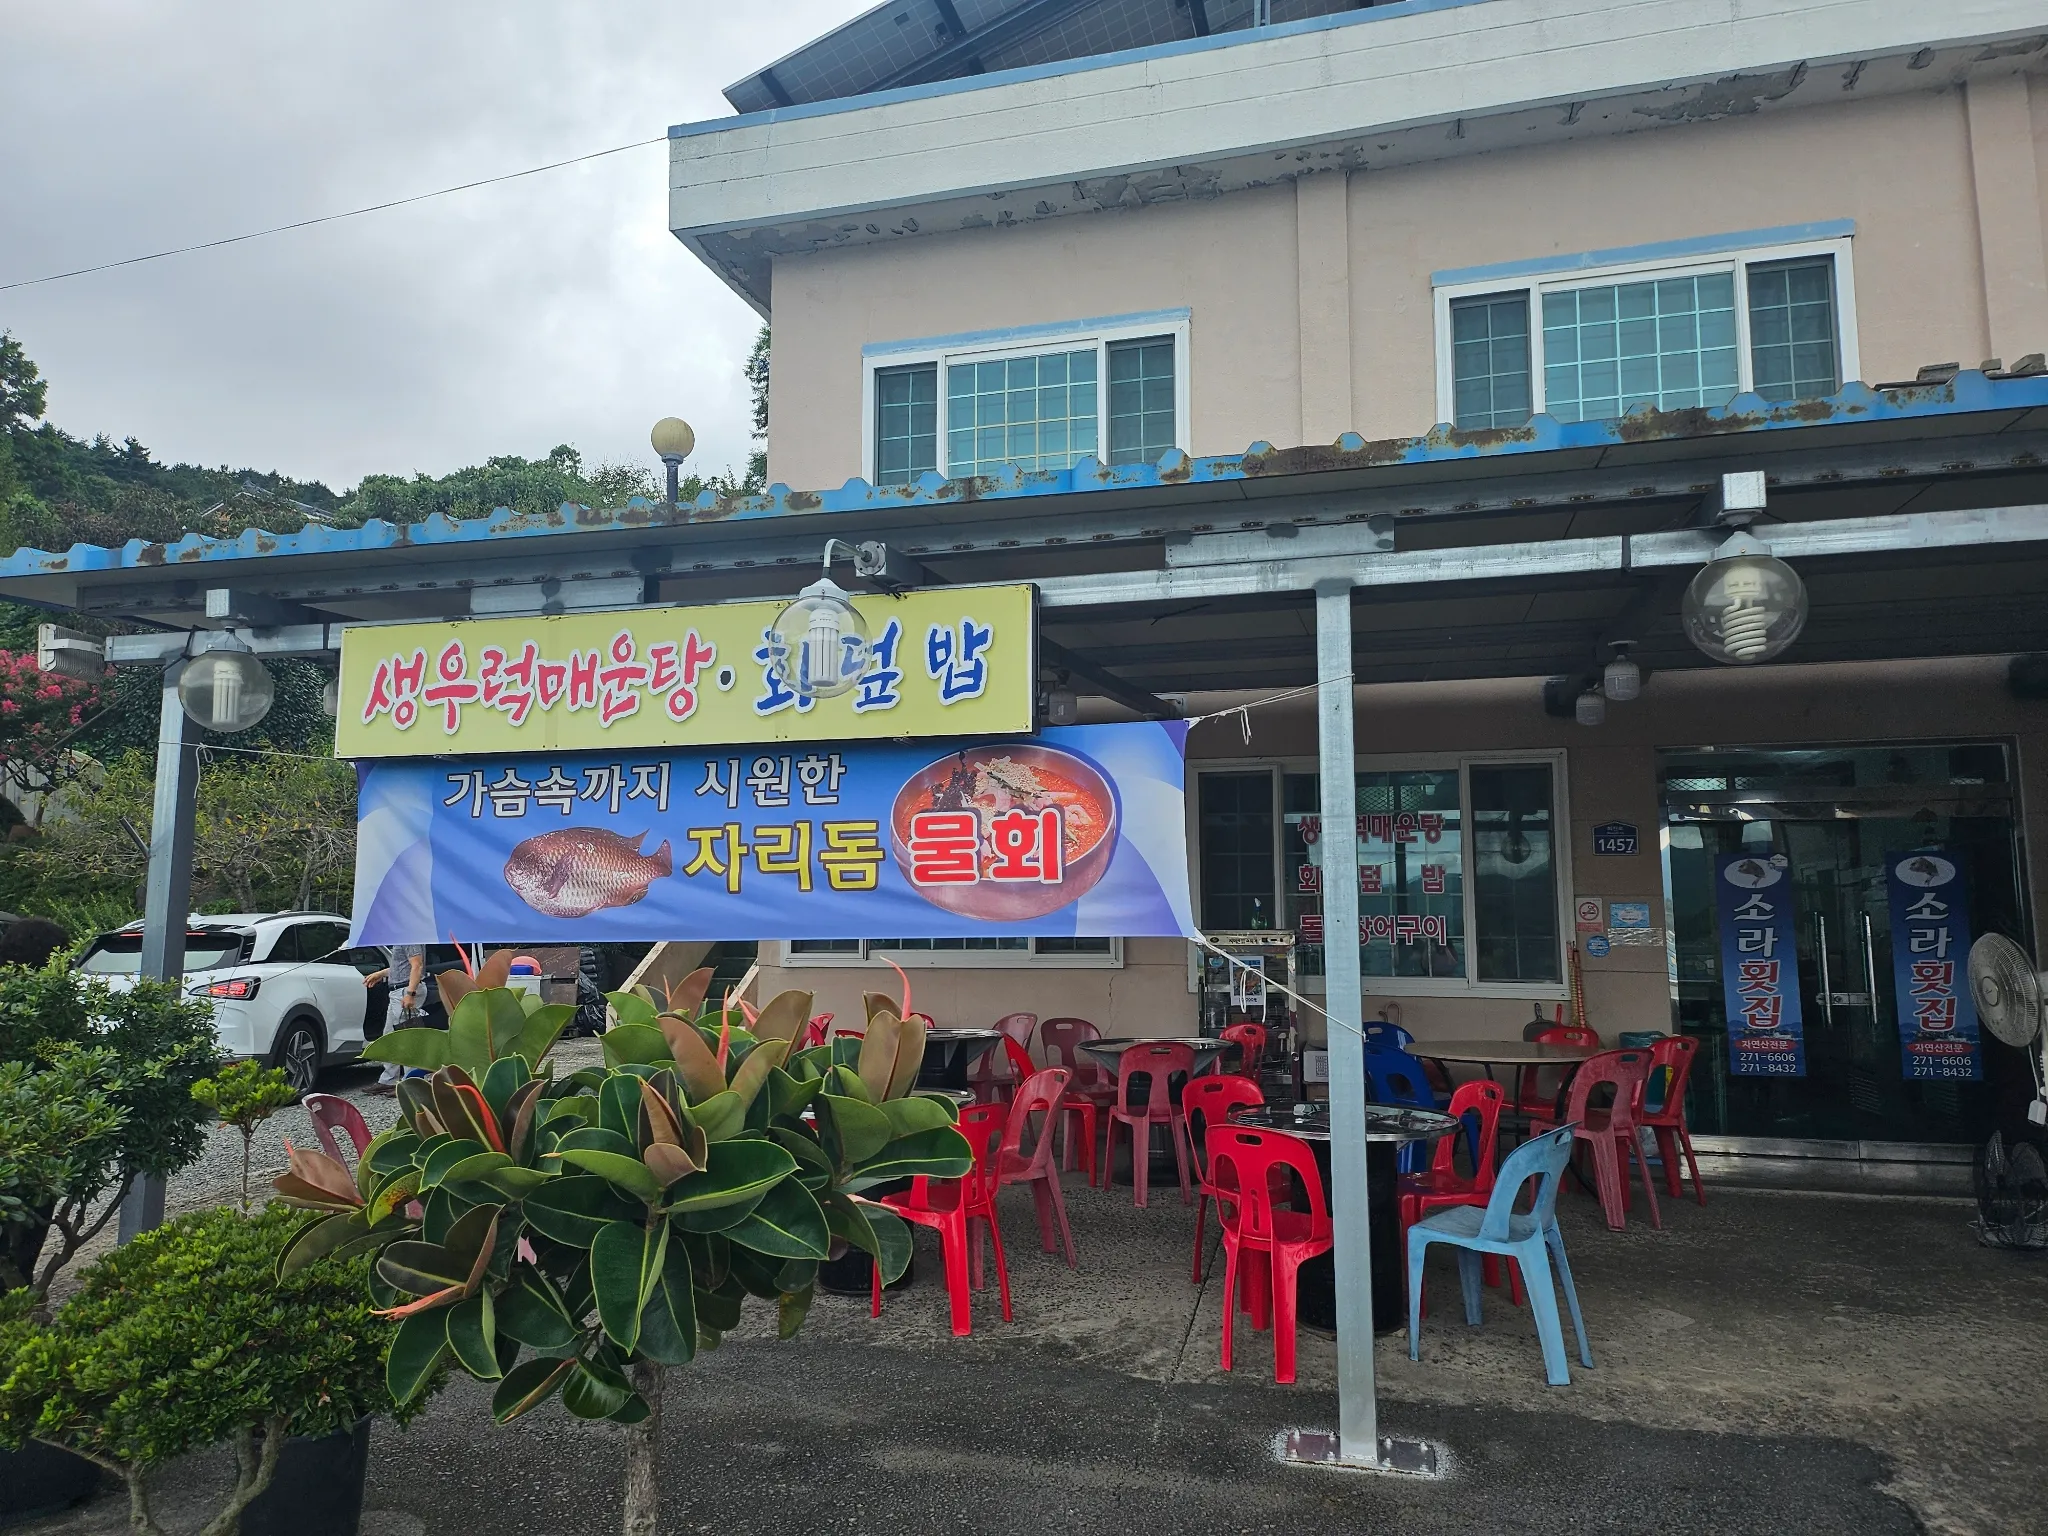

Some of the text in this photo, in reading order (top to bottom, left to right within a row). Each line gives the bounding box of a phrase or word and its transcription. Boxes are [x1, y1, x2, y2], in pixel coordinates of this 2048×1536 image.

[444, 754, 847, 818] 가슴속까지 시원한
[1297, 812, 1446, 844] 생럭매운탕
[683, 807, 1065, 893] 자리돔 물회
[1598, 838, 1635, 852] 1457
[1914, 1042, 1964, 1054] 자연산전문
[1739, 1052, 1796, 1062] 271-6606
[1912, 1055, 1972, 1066] 271-6606
[1740, 1062, 1797, 1074] 271-8432
[1913, 1066, 1973, 1078] 271-8432
